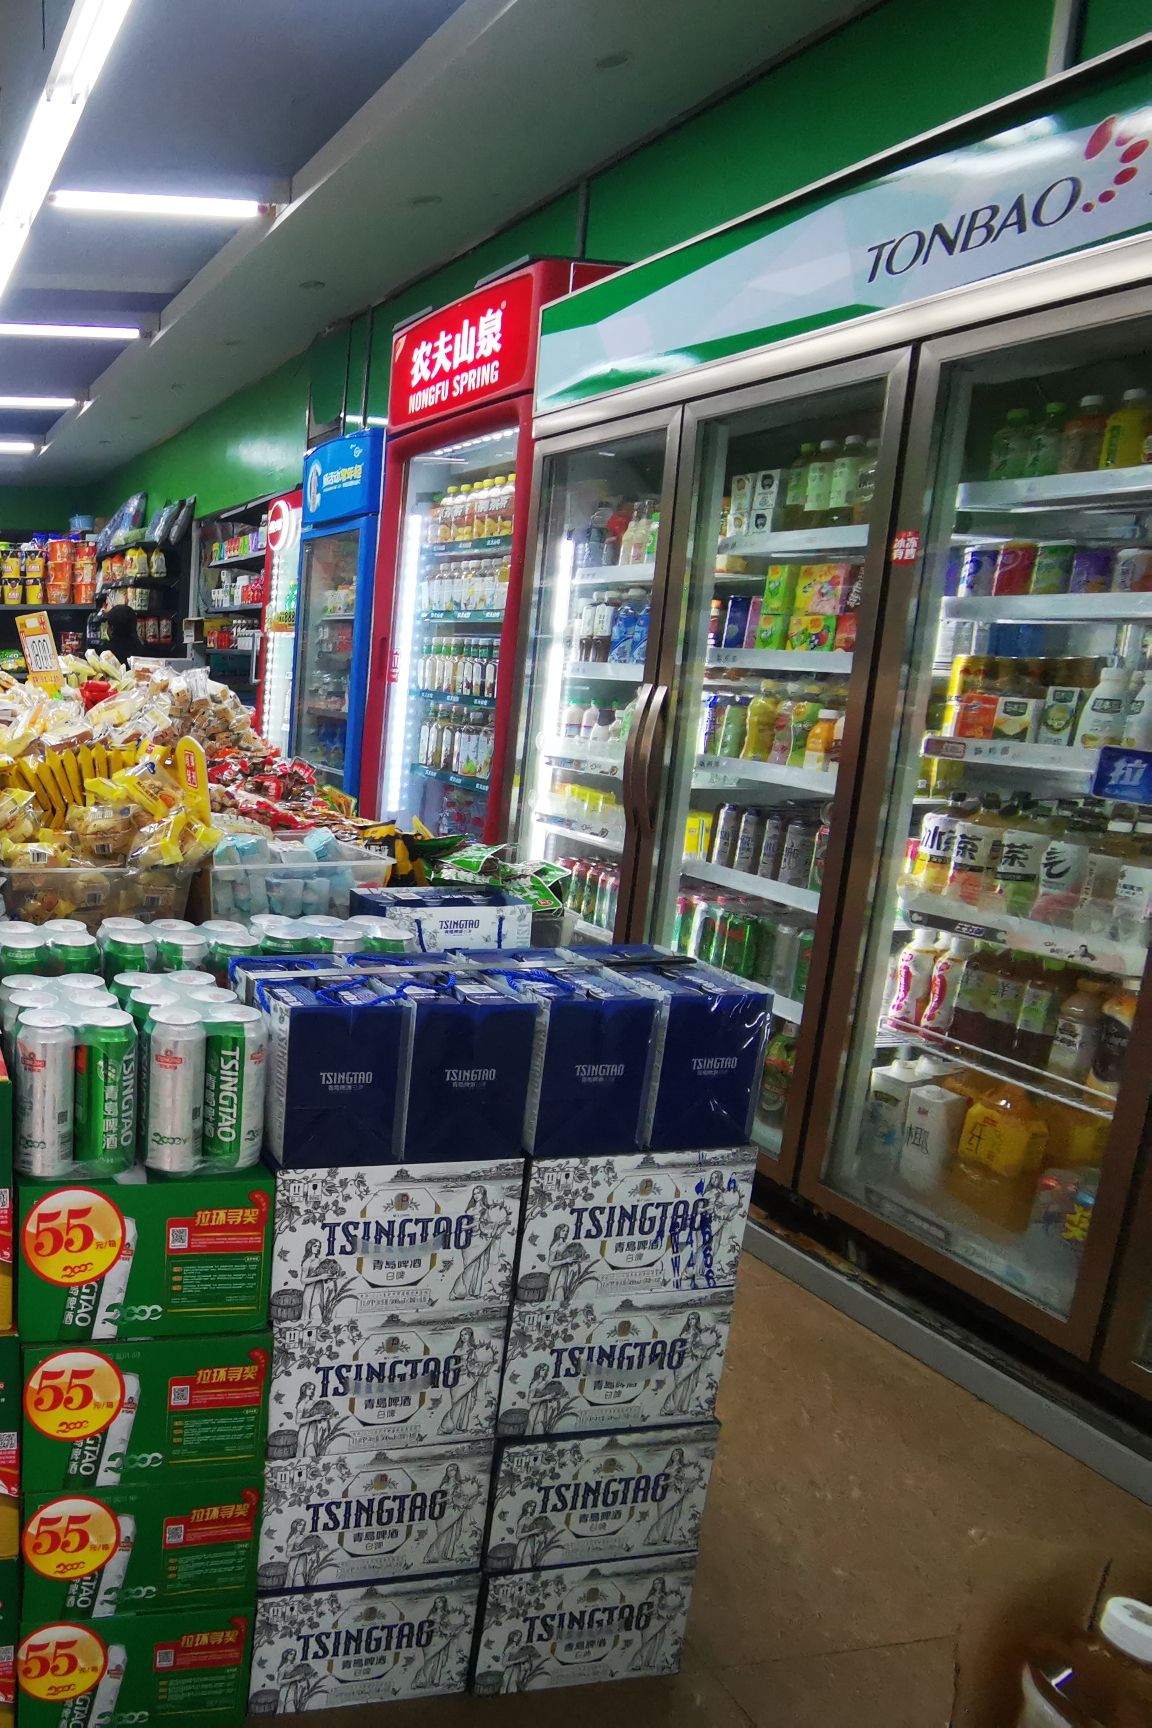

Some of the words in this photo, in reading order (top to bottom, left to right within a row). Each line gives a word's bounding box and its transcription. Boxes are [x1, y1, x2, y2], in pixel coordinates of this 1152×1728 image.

[867, 176, 1082, 283] TONBAO
[410, 308, 503, 387] 农夫山泉
[408, 379, 449, 414] NONGFU
[452, 361, 499, 397] SPRING
[217, 1046, 239, 1142] TSINGTAO
[320, 1072, 372, 1084] TSINGTAO
[445, 1069, 496, 1081] TSINGTAO
[34, 1206, 94, 1257] 55
[195, 1208, 259, 1226] 拉环寻奖
[34, 1368, 95, 1411] 55
[32, 1514, 91, 1555] 55
[23, 1640, 77, 1679] 55
